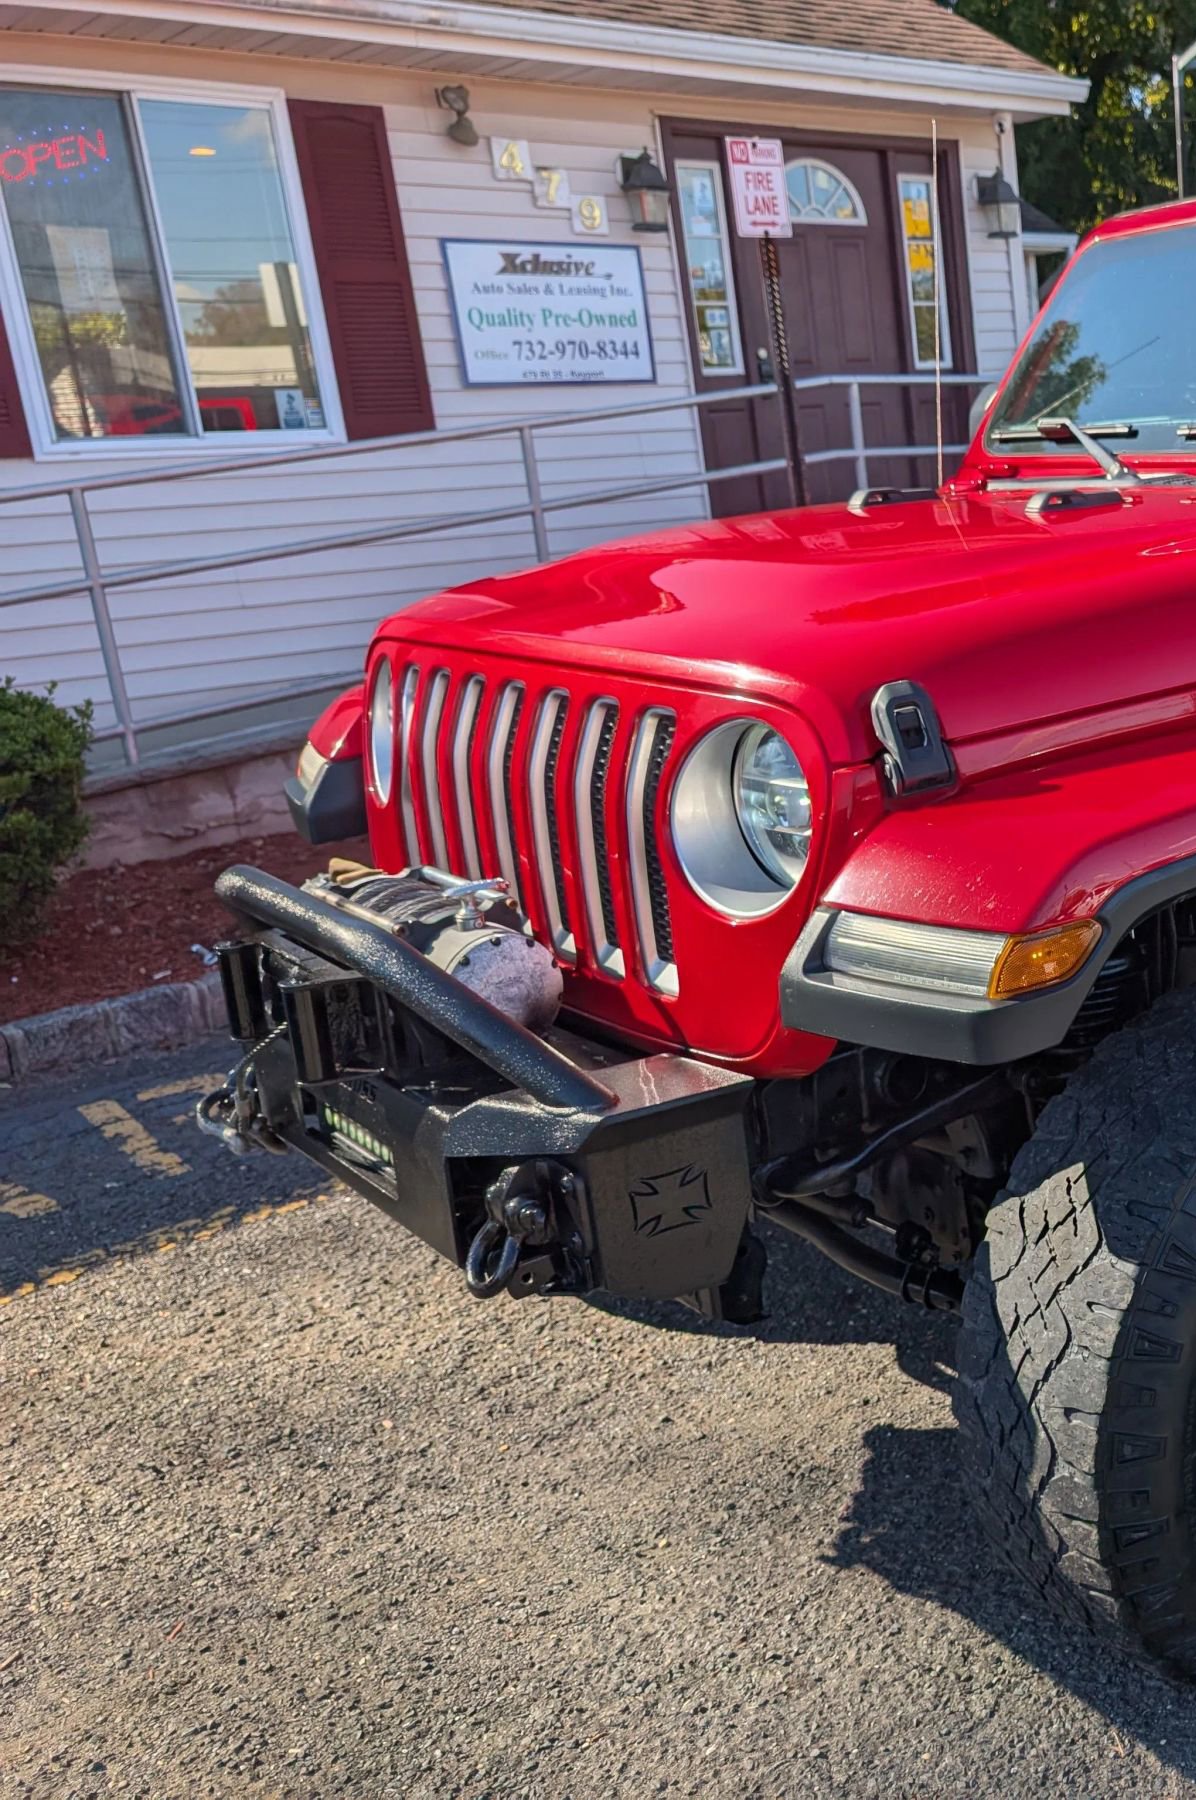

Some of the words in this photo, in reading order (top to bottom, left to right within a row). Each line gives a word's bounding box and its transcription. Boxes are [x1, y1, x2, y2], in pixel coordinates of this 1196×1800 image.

[0, 129, 107, 181] OPEN
[733, 143, 748, 161] NO
[744, 170, 774, 192] FIRE
[744, 194, 780, 216] LANE
[471, 282, 504, 295] Auto
[507, 283, 540, 296] Sales
[543, 284, 555, 296] &
[559, 284, 607, 298] Leasing
[467, 306, 536, 332] Quality
[540, 308, 638, 328] Pre-Owned
[512, 340, 640, 361] 732-970-8344
